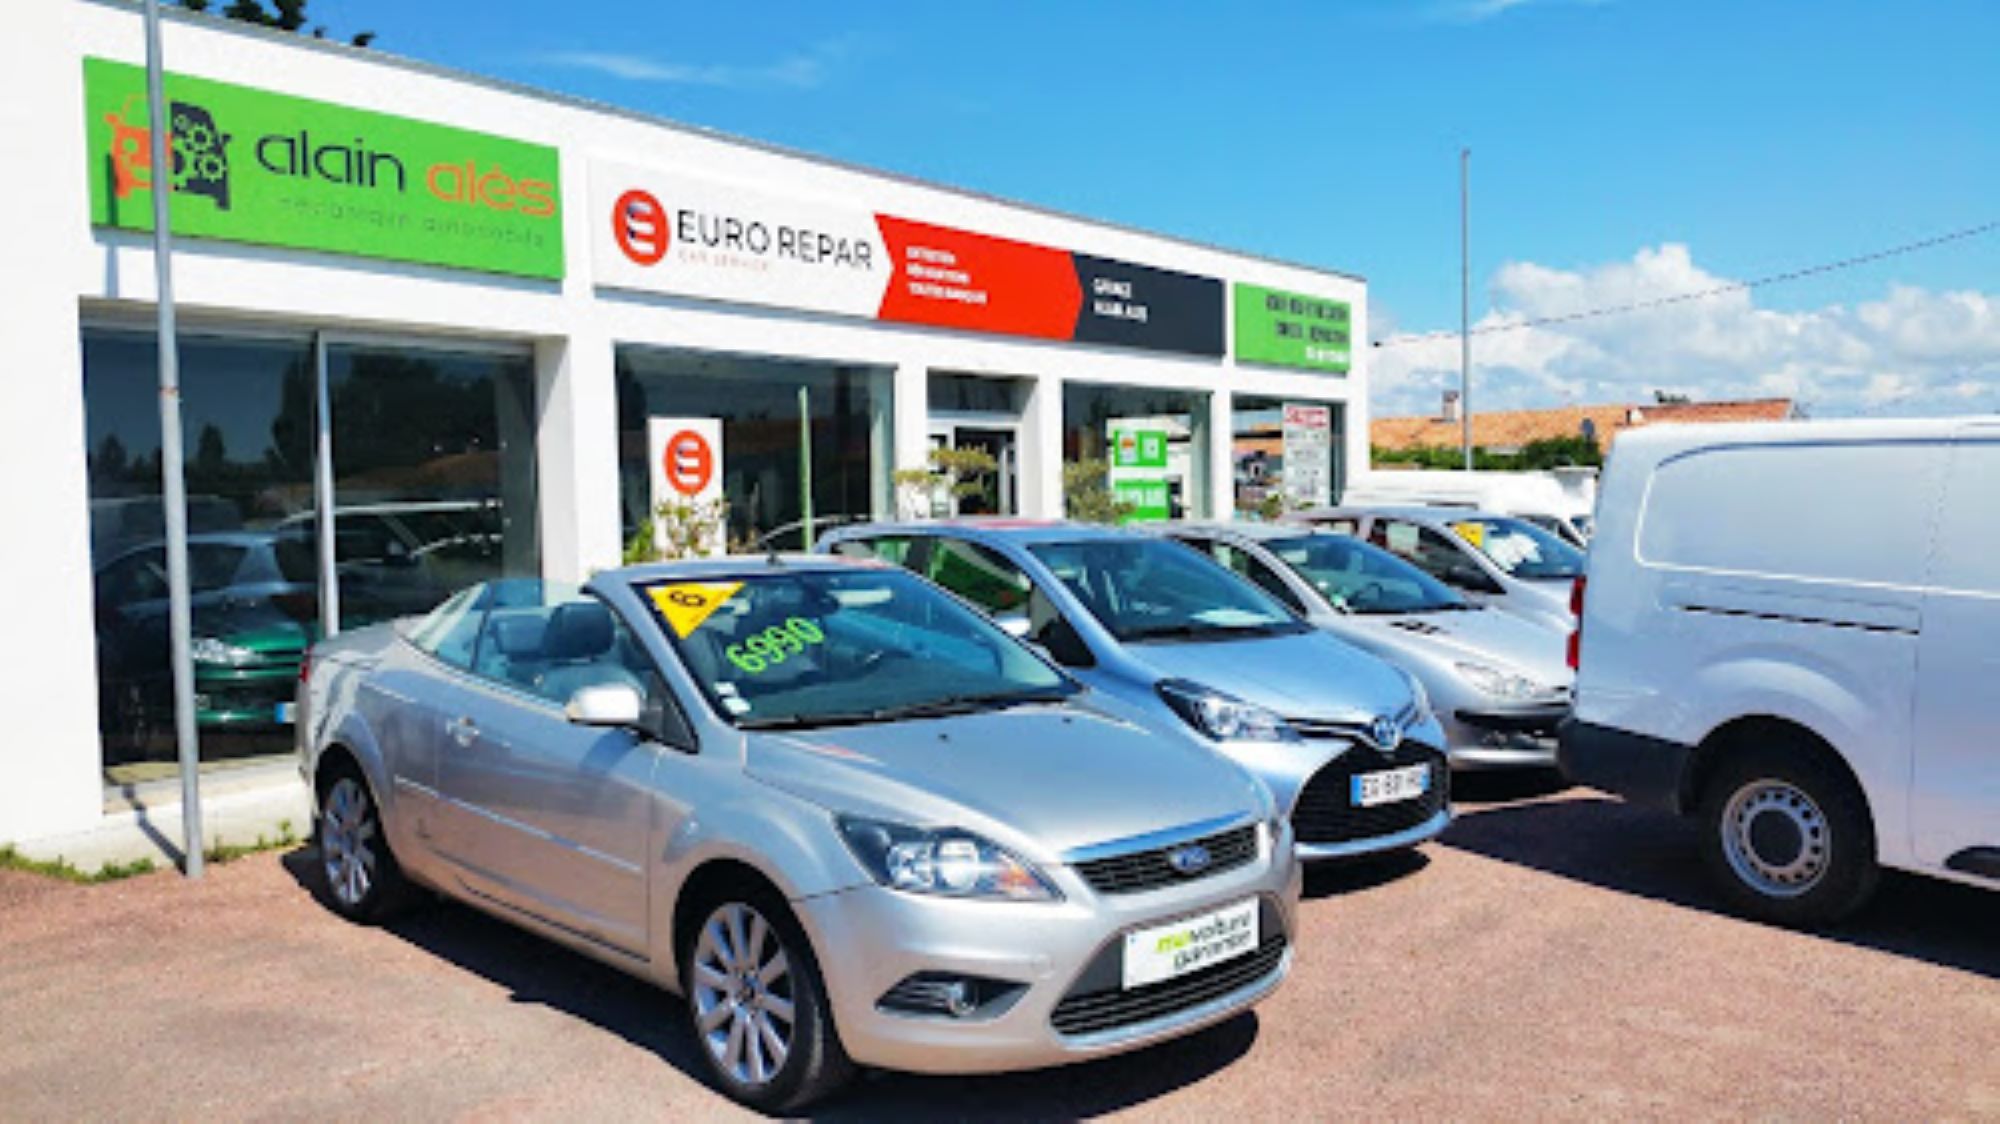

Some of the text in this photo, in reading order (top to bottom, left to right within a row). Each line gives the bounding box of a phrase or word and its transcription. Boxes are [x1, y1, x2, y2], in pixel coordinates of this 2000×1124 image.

[255, 129, 405, 192] alain
[677, 208, 872, 271] EURO REPAR
[726, 616, 825, 673] 6990
